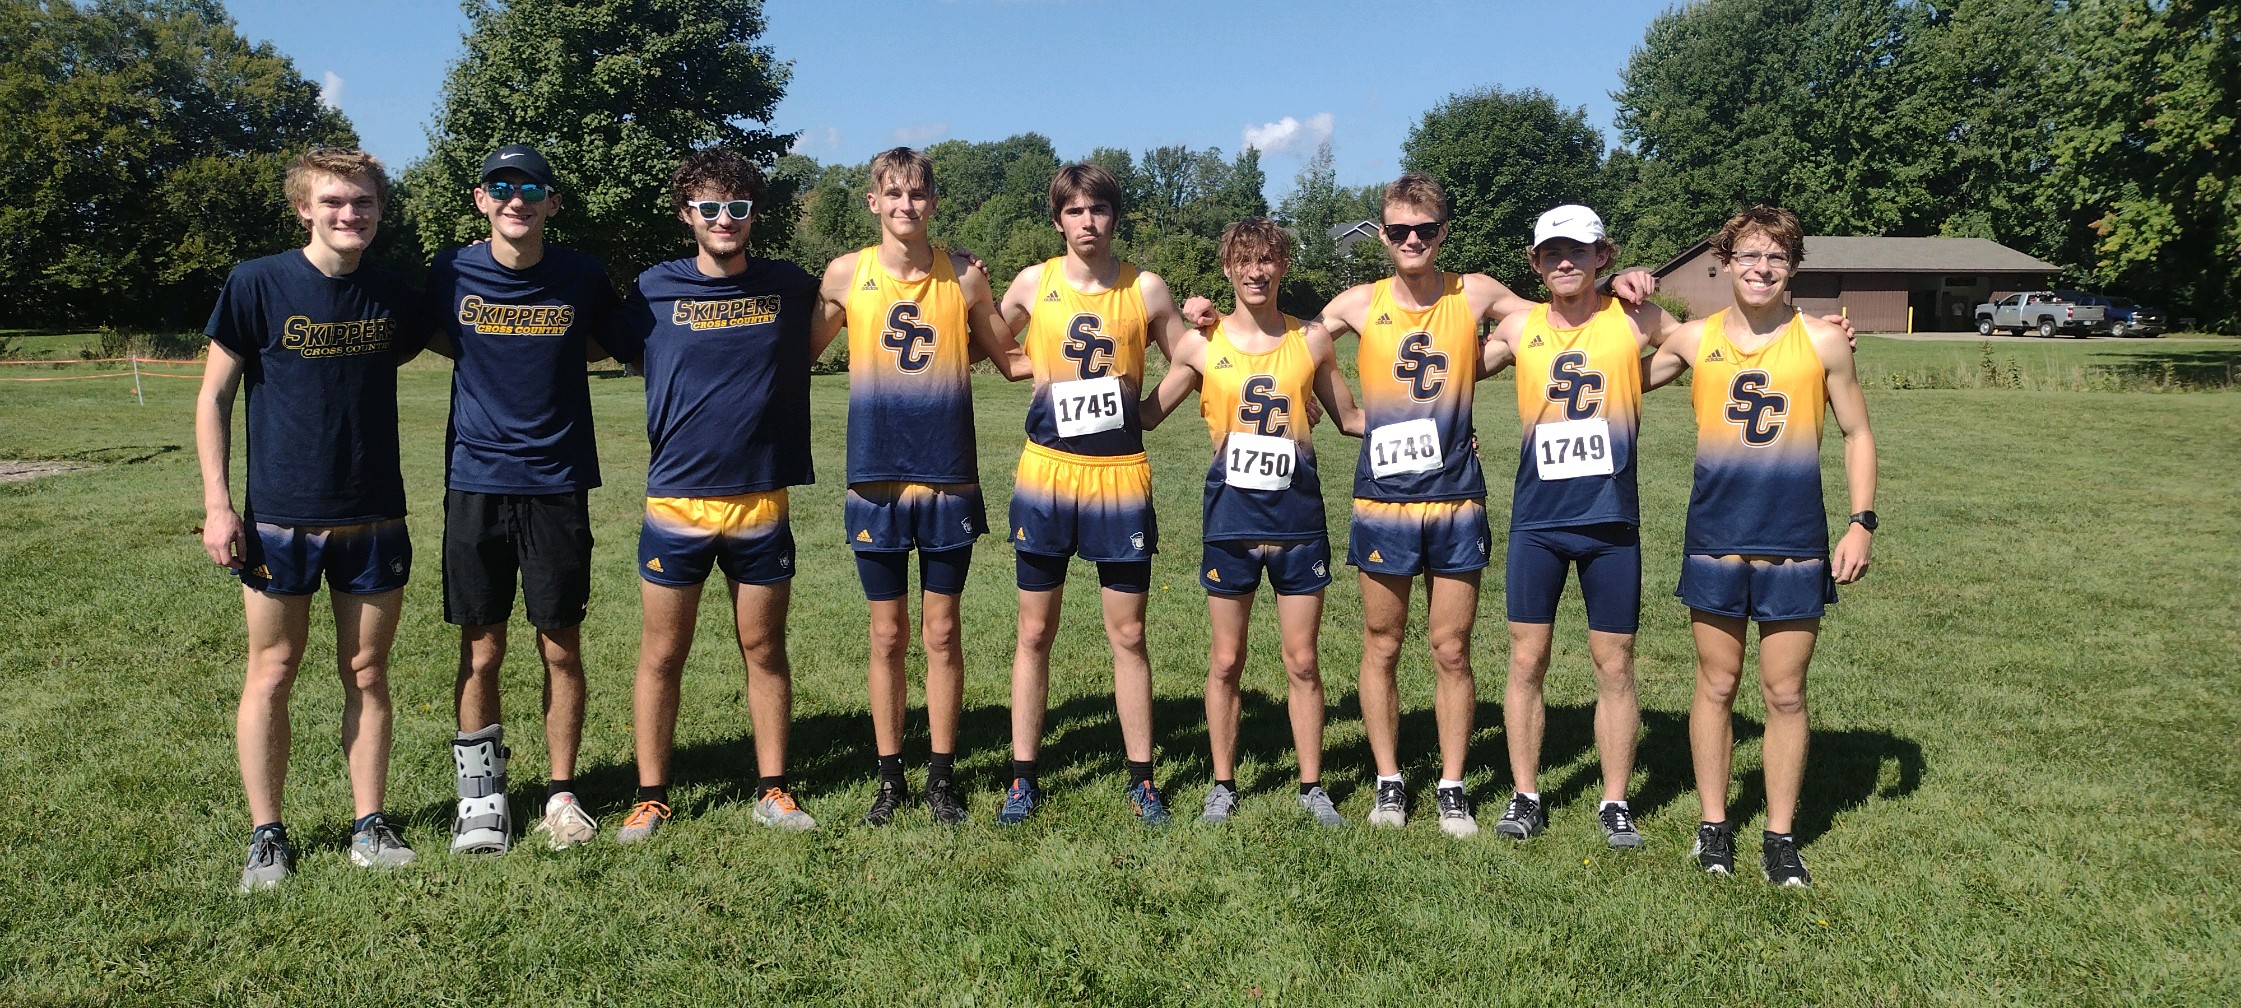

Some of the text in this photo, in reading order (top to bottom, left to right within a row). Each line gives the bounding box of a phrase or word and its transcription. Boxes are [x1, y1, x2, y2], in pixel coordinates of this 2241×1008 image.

[459, 295, 574, 327] SKIPPERS
[673, 295, 781, 325] SKIPPERS
[692, 313, 776, 330] CROSS COUNTRY
[282, 315, 396, 350] SKIPPERS
[477, 324, 566, 335] CROSS COUNTRY
[881, 300, 937, 374] SC
[303, 341, 391, 357] CROSS COUNTR
[1062, 312, 1117, 381] SC
[1393, 331, 1450, 404] SC
[1545, 350, 1605, 422] SC
[1059, 392, 1118, 422] 1745
[1237, 374, 1291, 438] SC
[1723, 369, 1789, 448] SC
[1230, 447, 1291, 478] 1750
[1375, 433, 1435, 467] 1748
[1541, 434, 1605, 465] 1749
